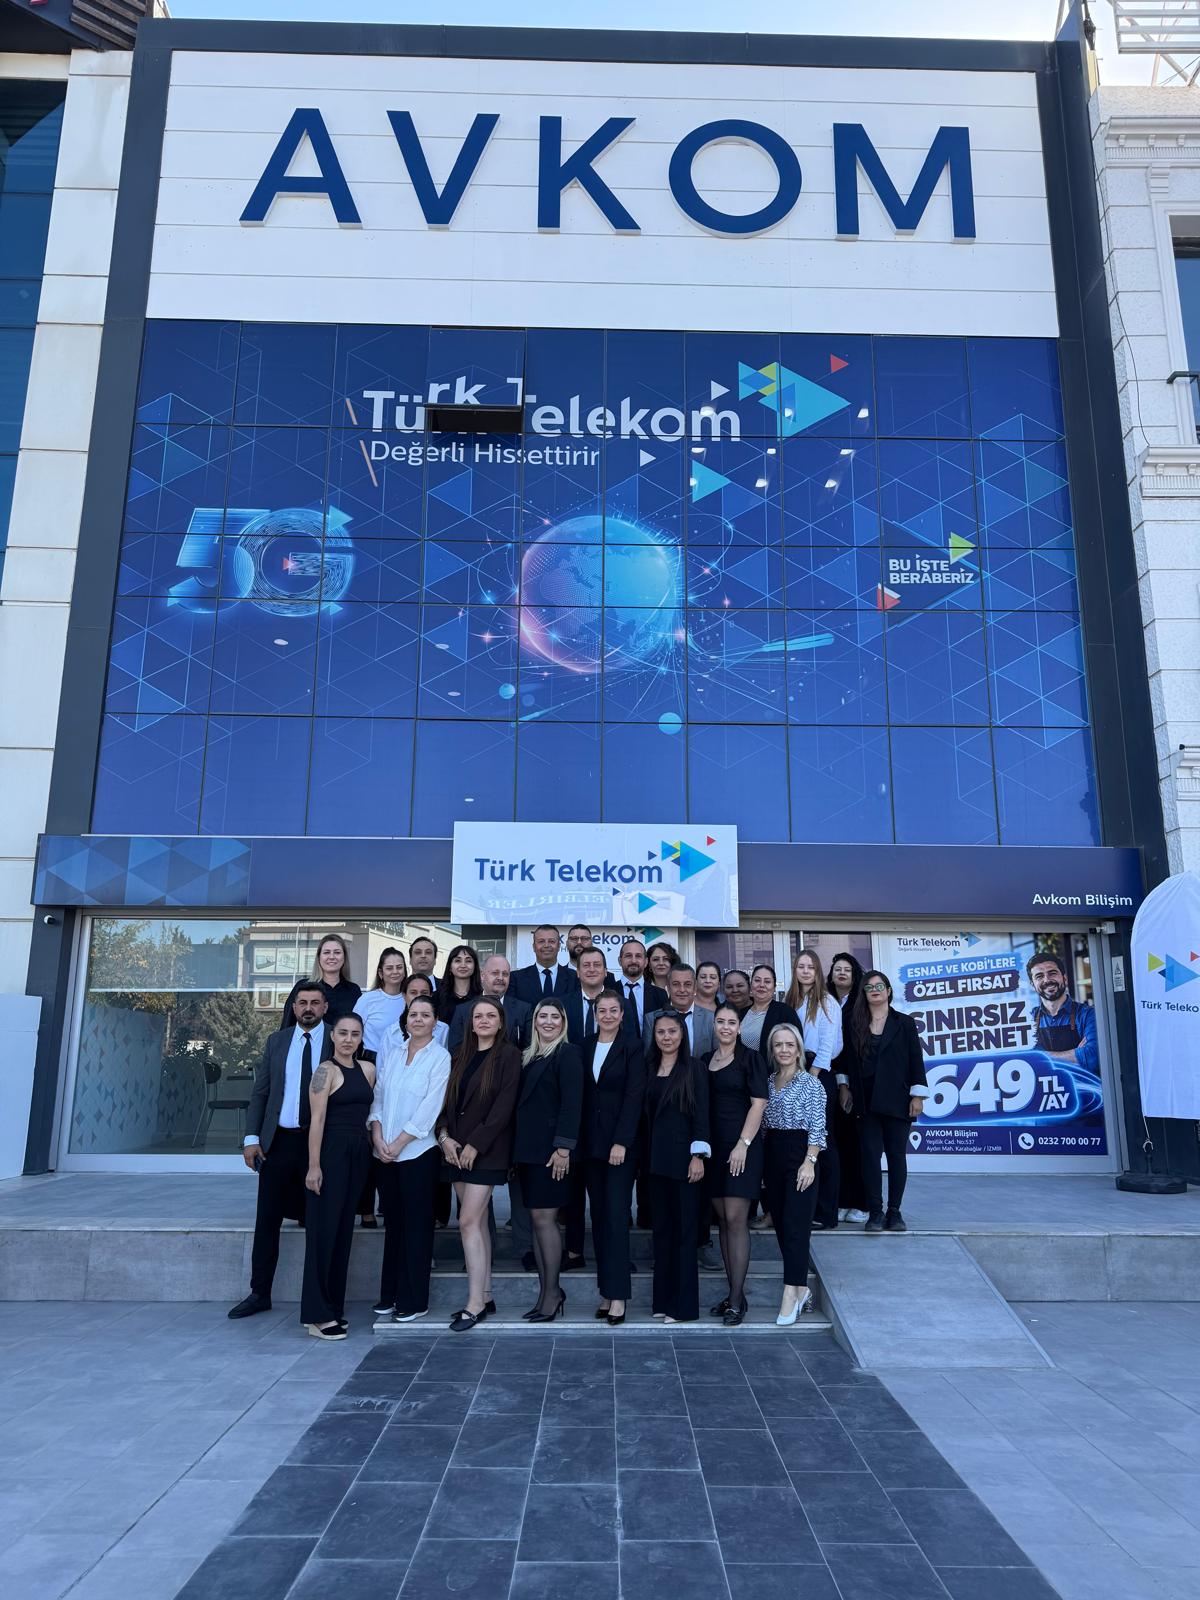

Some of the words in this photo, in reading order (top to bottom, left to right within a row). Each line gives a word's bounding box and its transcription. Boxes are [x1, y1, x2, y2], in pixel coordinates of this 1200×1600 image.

[239, 107, 977, 244] AVKOM
[506, 378, 741, 442] Telekom
[371, 440, 464, 466] Değerli
[475, 442, 599, 466] Hissettirir
[166, 508, 354, 617] 5G
[889, 559, 911, 571] BU
[916, 554, 950, 573] İŞTE
[889, 568, 975, 584] BERABERİZ
[474, 857, 536, 882] Türk
[545, 858, 662, 884] Telekom
[1032, 893, 1081, 905] Avkom
[1085, 894, 1133, 909] Bilişim
[897, 937, 918, 946] Türk
[920, 938, 960, 947] Telekom
[907, 965, 943, 978] ESNAF
[945, 964, 959, 974] VE
[961, 956, 1016, 973] KOBİ'LERE
[913, 981, 954, 998] ÖZEL
[958, 974, 1012, 993] FIRSAT
[1140, 1000, 1162, 1010] Türk
[1165, 1001, 1200, 1012] Teleko
[908, 1001, 1027, 1034] SINIRSIZ
[918, 1025, 1032, 1057] NTERNET
[922, 1059, 1036, 1119] 649
[1038, 1076, 1065, 1092] TL
[1039, 1092, 1070, 1113] /AY
[925, 1129, 953, 1137] AVKOM
[954, 1129, 978, 1139] Bilişim
[1038, 1136, 1059, 1146] 0232
[1060, 1136, 1076, 1146] 700
[1078, 1136, 1089, 1146] 00
[1089, 1137, 1101, 1146] 77
